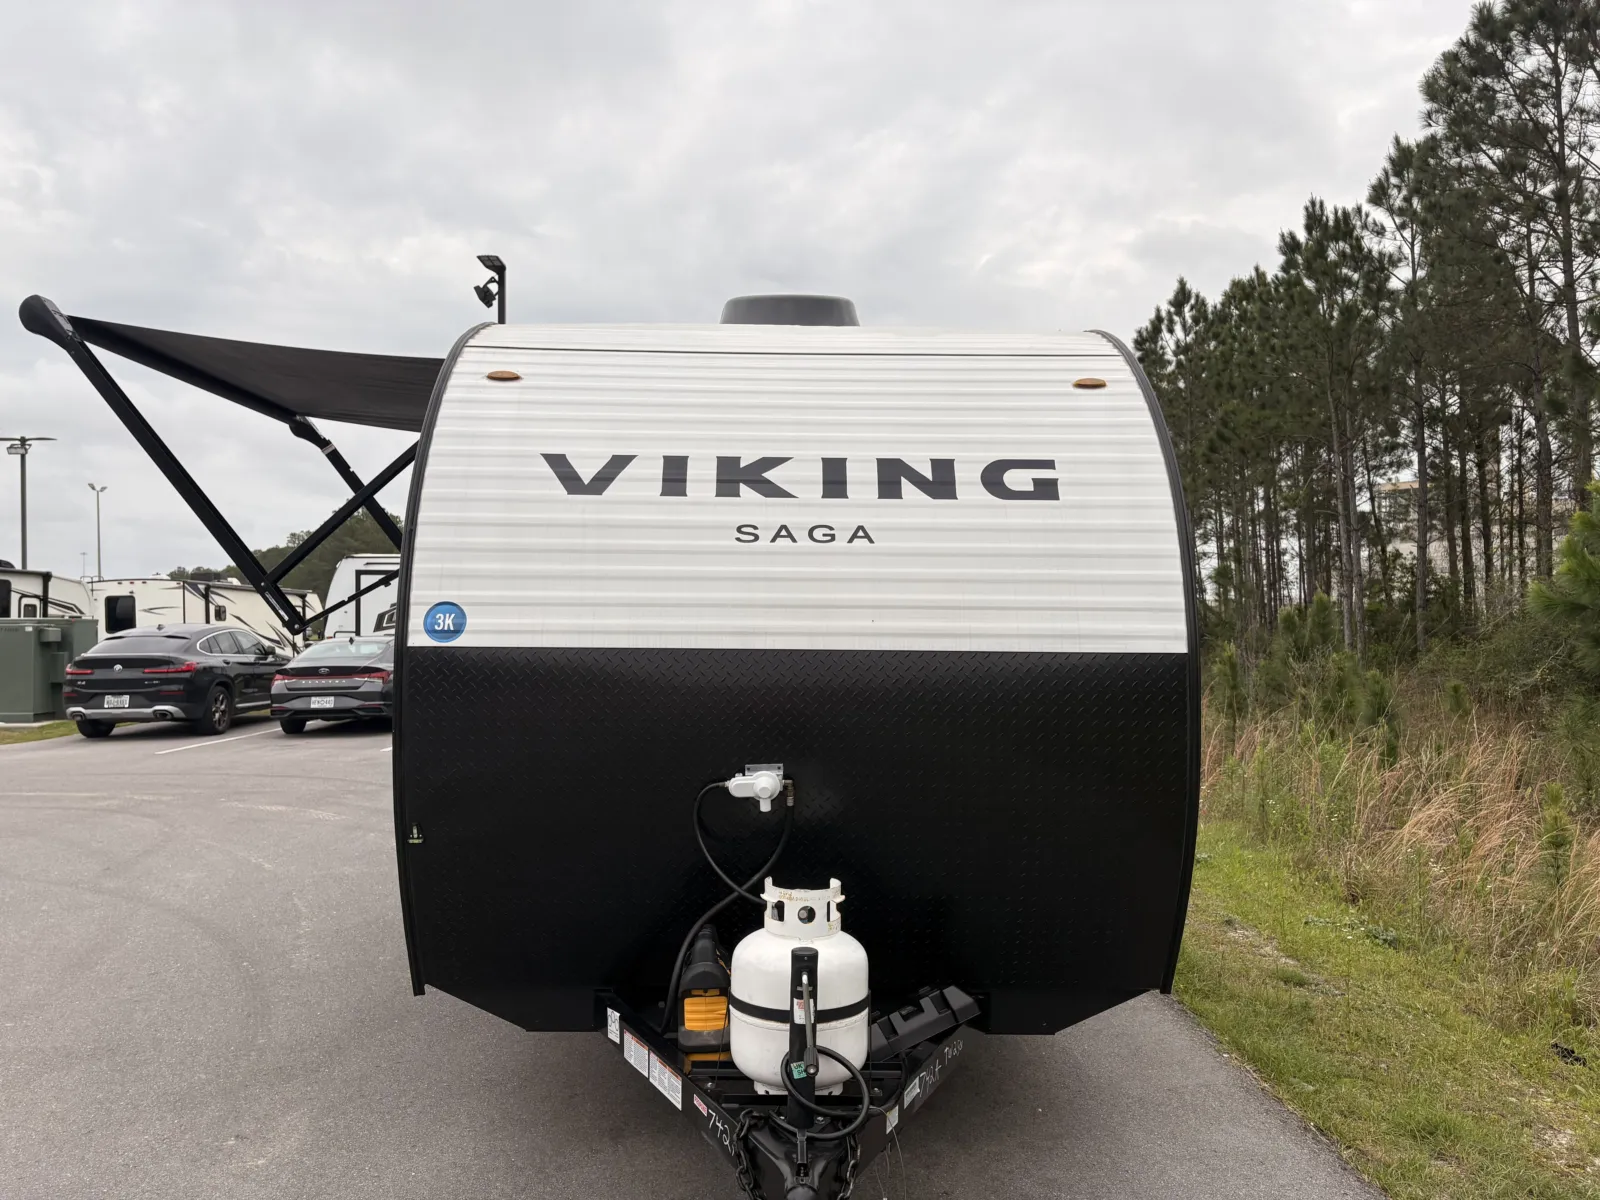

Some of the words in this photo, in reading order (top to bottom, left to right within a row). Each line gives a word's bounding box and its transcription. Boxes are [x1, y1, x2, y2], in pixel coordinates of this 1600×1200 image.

[540, 453, 1060, 501] VIKING
[734, 524, 876, 545] SAGA
[434, 613, 456, 631] 3K
